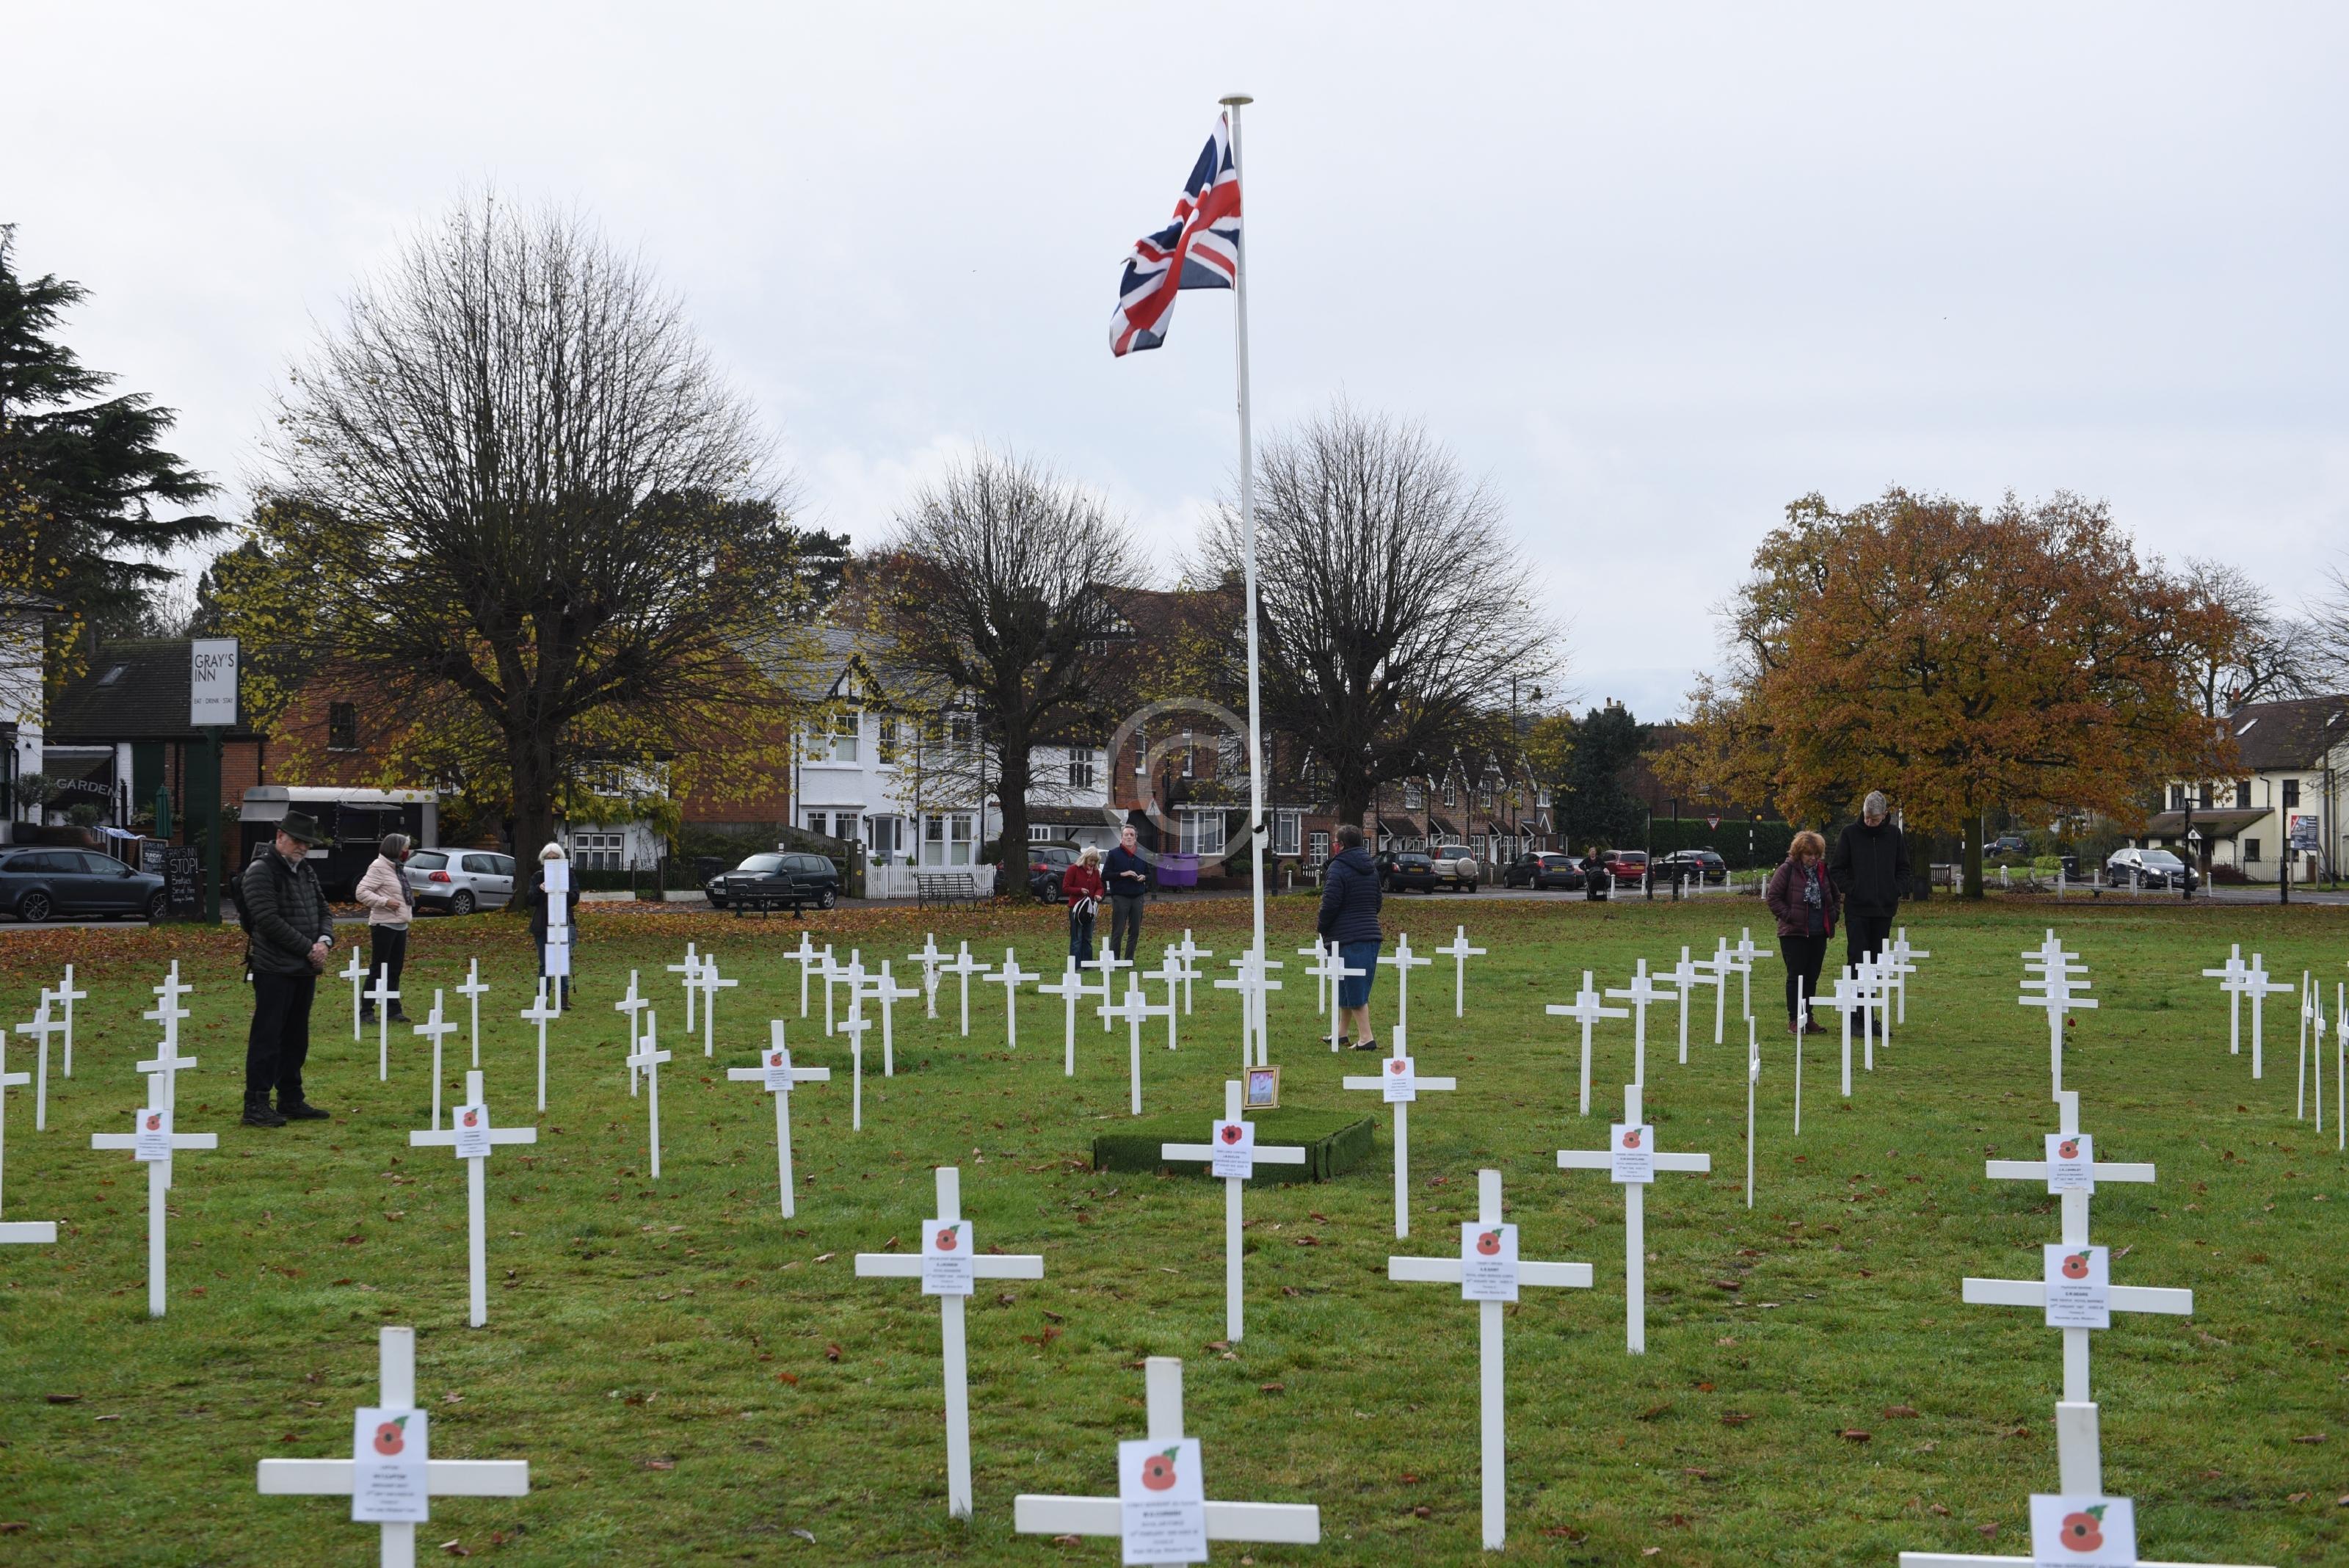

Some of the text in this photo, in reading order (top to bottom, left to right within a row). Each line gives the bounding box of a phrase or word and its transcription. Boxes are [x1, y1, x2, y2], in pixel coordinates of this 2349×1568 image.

[195, 653, 234, 668] GRAY'S
[195, 669, 216, 682] INN
[57, 779, 117, 797] GARDEN
[170, 858, 198, 874] STOP!
